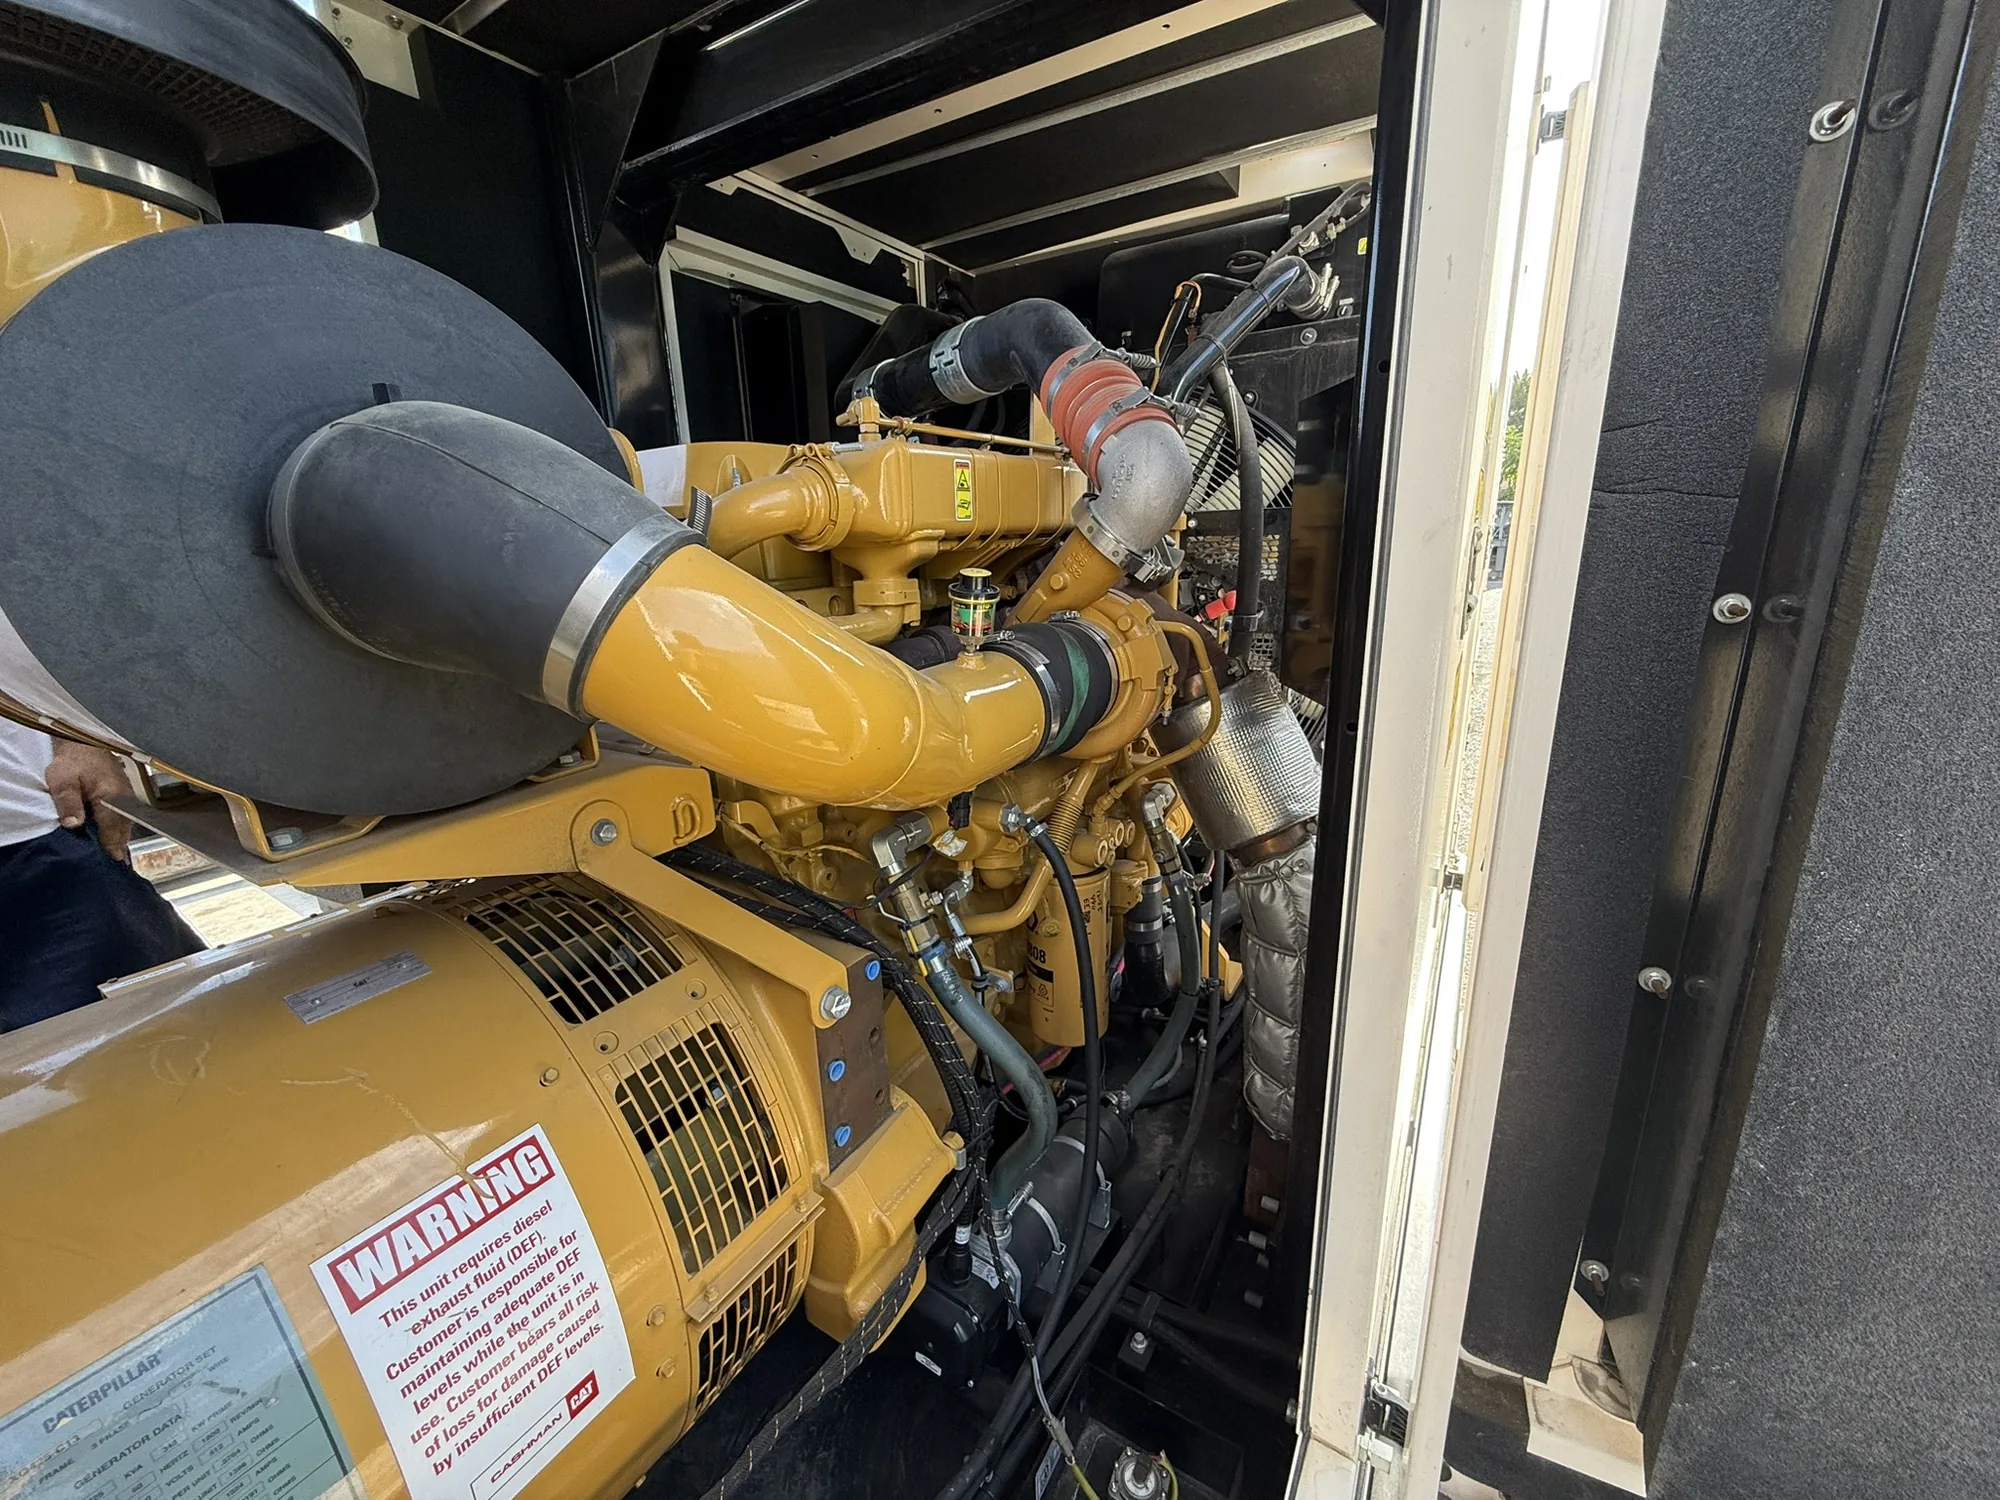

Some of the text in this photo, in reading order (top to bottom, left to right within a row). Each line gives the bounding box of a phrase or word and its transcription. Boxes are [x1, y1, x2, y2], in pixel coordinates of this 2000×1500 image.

[336, 1144, 549, 1301] WARNING
[378, 1199, 553, 1328] This unit requires diesel
[410, 1229, 547, 1336] exhaust fluid (DEF).
[386, 1230, 578, 1381] Customer is responsible for
[400, 1248, 583, 1399] maintaining adequate DEF
[412, 1271, 585, 1415] levels while the unit is in
[42, 1351, 162, 1434] CATERPILLAR
[123, 1361, 195, 1410] GENERATOR
[195, 1345, 216, 1362] SET
[409, 1281, 600, 1444] use. Customer bears all risk
[424, 1300, 601, 1458] of loss for damage caused
[432, 1324, 604, 1476] by insufficient DEF levels.
[570, 1380, 594, 1407] CAT
[38, 1458, 76, 1485] FRAME
[207, 1356, 230, 1372] WIRE
[73, 1414, 182, 1490] GENERATOR DATA
[124, 1464, 143, 1479] KVA
[191, 1420, 205, 1433] KW
[206, 1400, 233, 1421] PRIME
[159, 1450, 189, 1473] HERTZ
[230, 1398, 263, 1424] REV/MIN
[165, 1464, 194, 1487] VOLTS
[237, 1417, 260, 1436] AMPS
[256, 1437, 279, 1456] OHMS
[490, 1412, 563, 1484] CASHMAN
[171, 1485, 191, 1500] PER
[192, 1469, 211, 1487] UNIT
[250, 1424, 274, 1443] OHMS
[255, 1456, 277, 1477] AMPS
[267, 1463, 291, 1483] OHMS
[273, 1475, 296, 1495] OHMS
